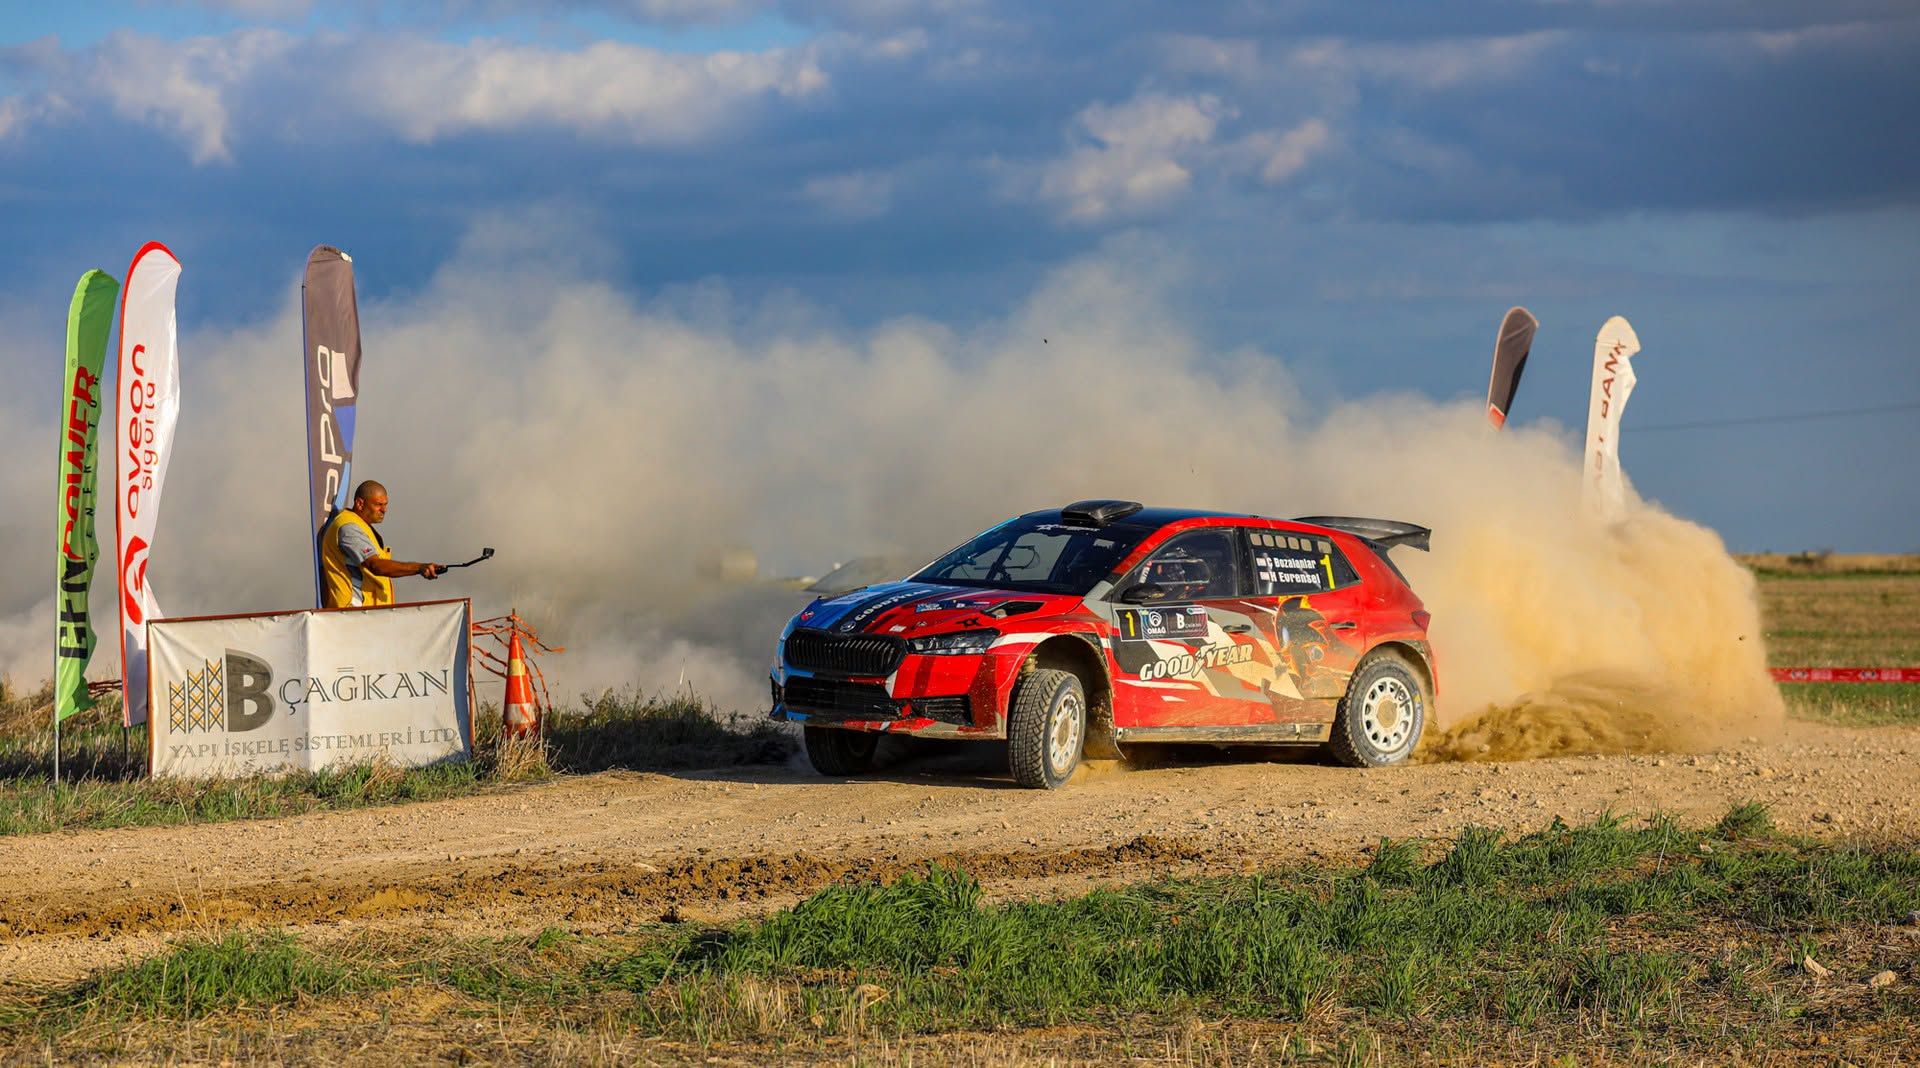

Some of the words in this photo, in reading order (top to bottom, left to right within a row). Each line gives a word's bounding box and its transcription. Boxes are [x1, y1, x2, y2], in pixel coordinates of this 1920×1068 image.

[127, 344, 145, 519] aveon
[142, 382, 158, 490] sigorta
[317, 345, 343, 522] oPro
[1278, 571, 1321, 584] Evrensel
[1320, 554, 1336, 590] 1
[1125, 611, 1136, 637] 1
[1140, 643, 1254, 681] GOODYEAR
[225, 648, 276, 732] B
[279, 667, 449, 715] ÇAĞKAN
[169, 743, 219, 758] YAPI
[294, 726, 412, 751] SİSTEMLERİ
